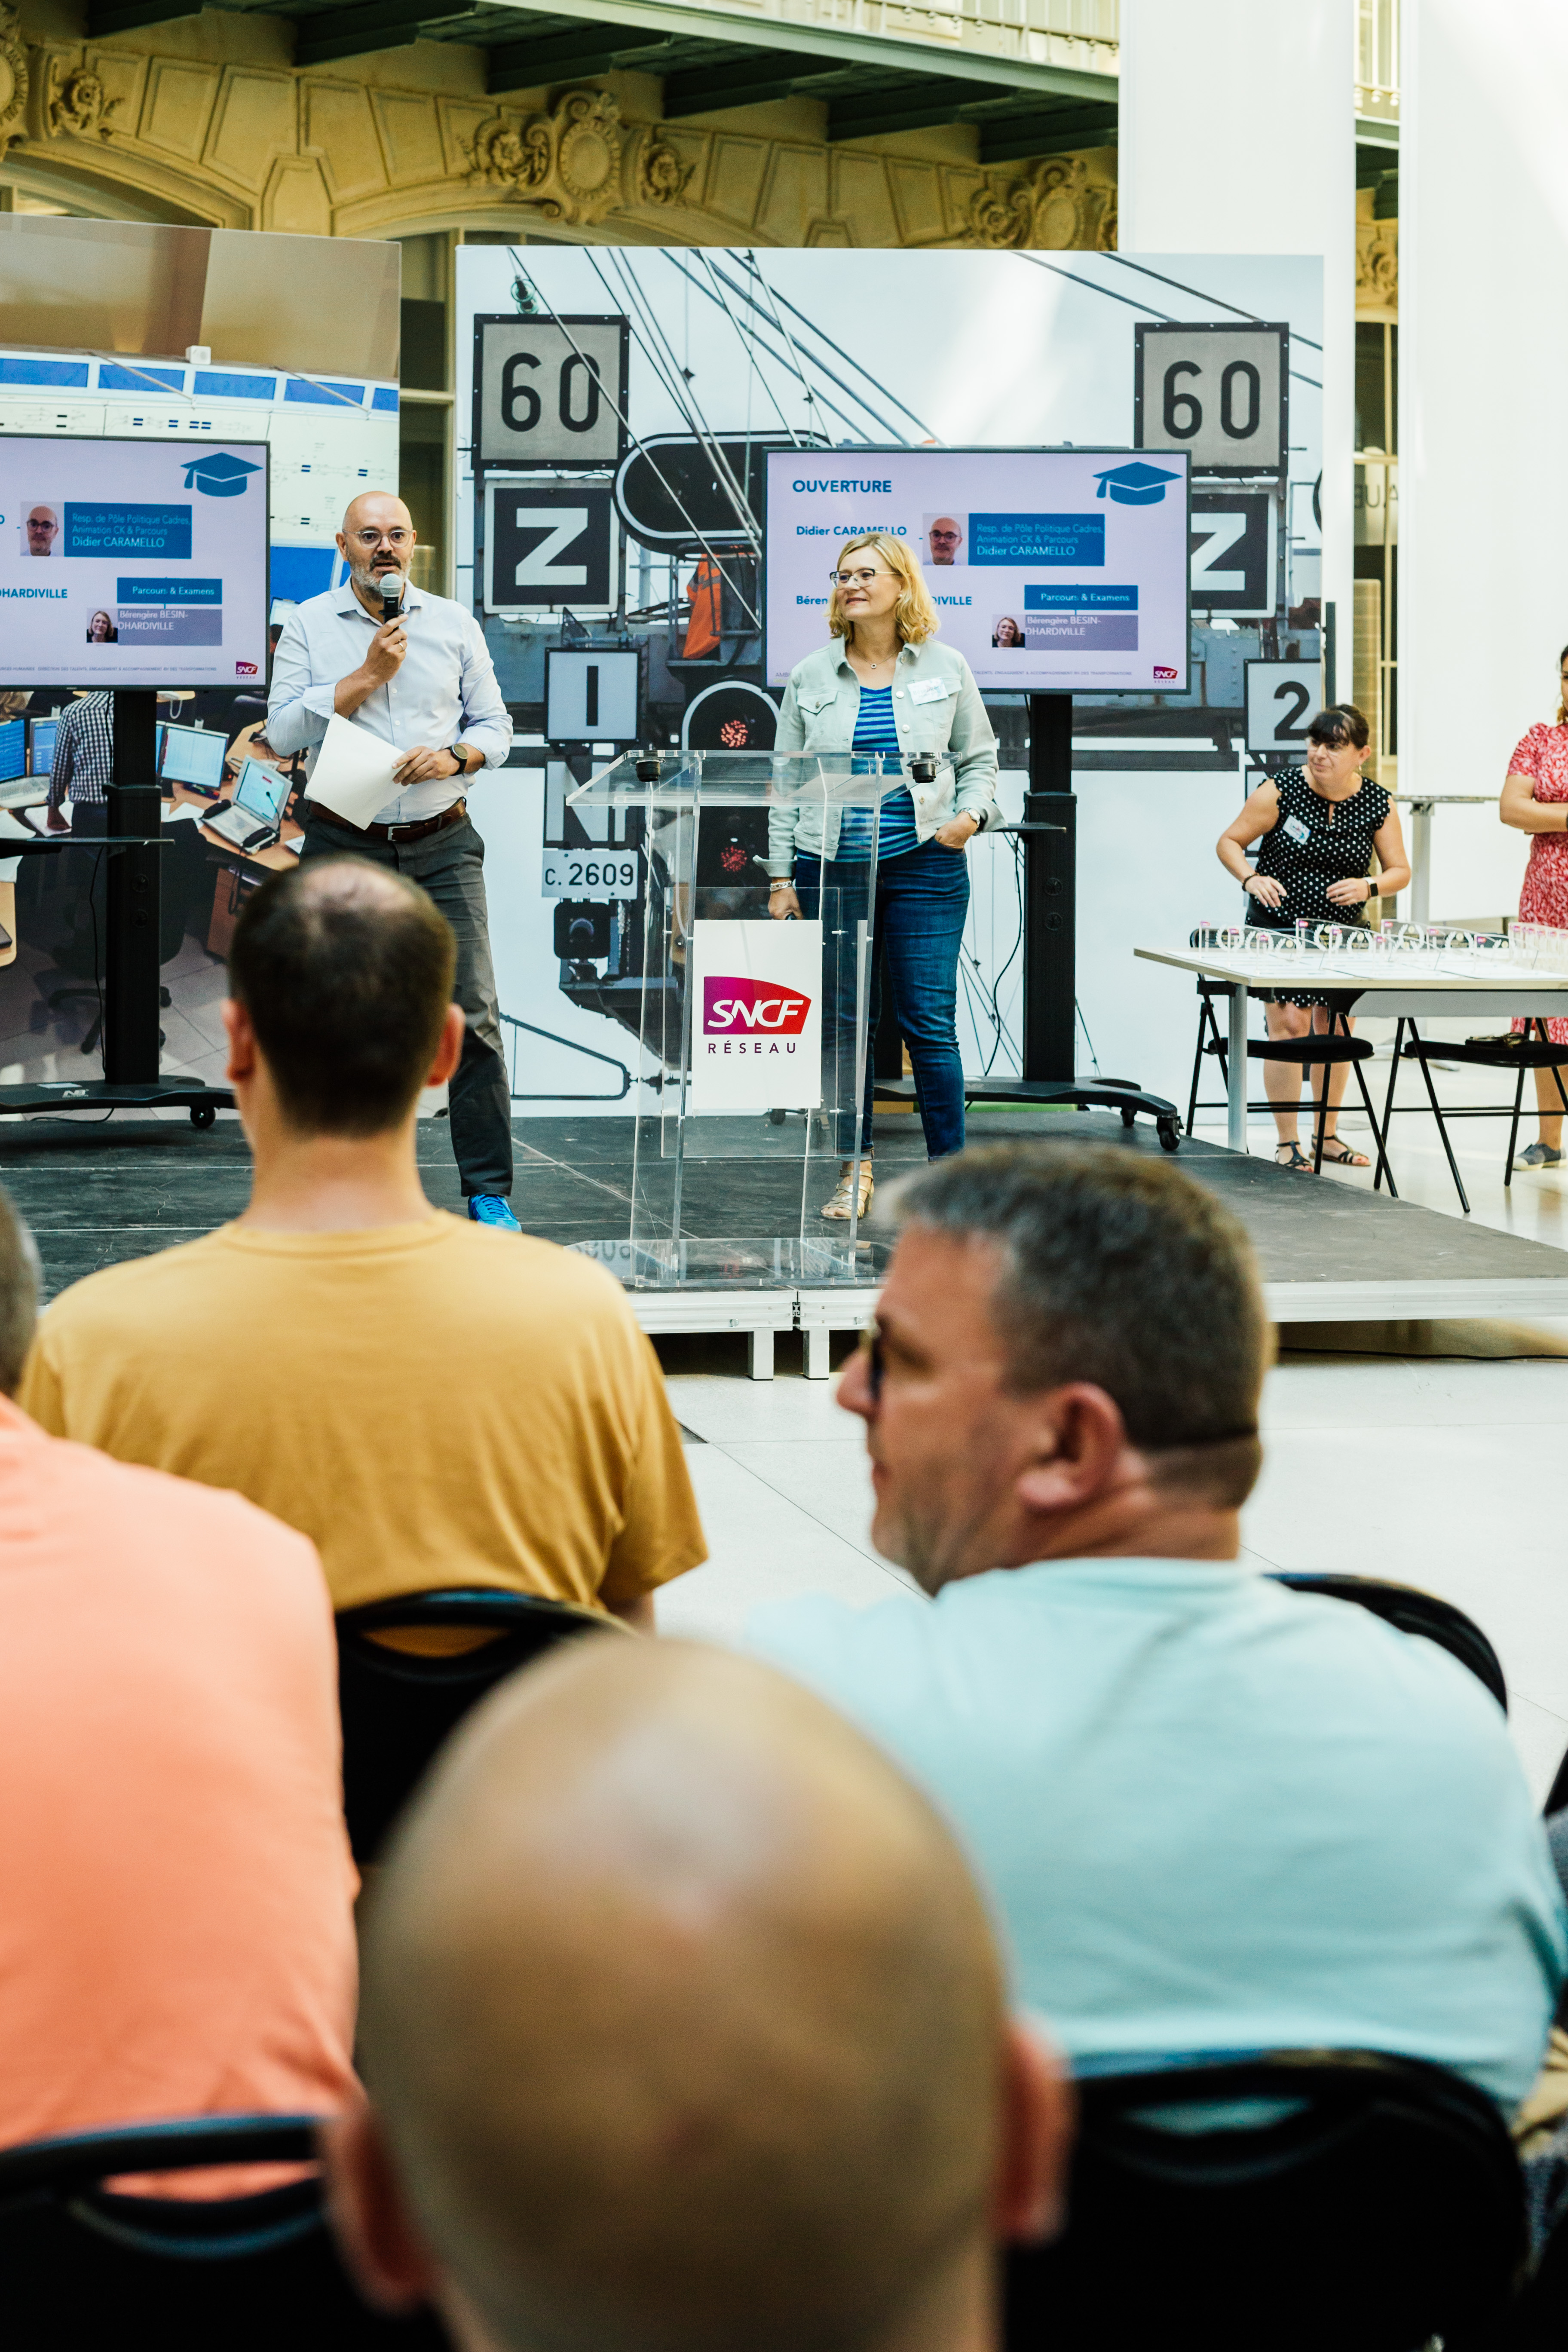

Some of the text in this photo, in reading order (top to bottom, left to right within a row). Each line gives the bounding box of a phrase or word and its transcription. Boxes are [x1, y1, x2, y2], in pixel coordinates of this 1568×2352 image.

[502, 352, 600, 433] 60
[1164, 361, 1260, 440] 60
[793, 480, 892, 493] OUVERTURE
[95, 514, 106, 523] de
[127, 514, 160, 525] Politique
[72, 525, 168, 535] Animation CK & Parcours
[796, 526, 830, 535] Didier
[1001, 524, 1012, 533] de
[1035, 524, 1071, 534] Politique
[73, 536, 165, 548] Didier CARAMELLO
[977, 535, 1078, 544] Animation CK & Parcours
[516, 508, 588, 586] Z
[977, 545, 1075, 556] Didier CARAMELLO
[1191, 513, 1246, 591] Z
[0, 588, 67, 598] HARDIVILLE
[132, 586, 167, 594] Parcours
[179, 587, 214, 595] Examens
[796, 595, 828, 604] Béren
[1090, 593, 1130, 601] Examens
[120, 610, 158, 620] Bérengère
[1027, 616, 1068, 625] Bérengère
[118, 622, 174, 630] DHARDIVILLE
[1026, 628, 1086, 636] DHARDIVILLE
[1273, 681, 1310, 741] 2
[707, 1000, 803, 1028] SNCF
[708, 1040, 796, 1054] RÉSEAU
